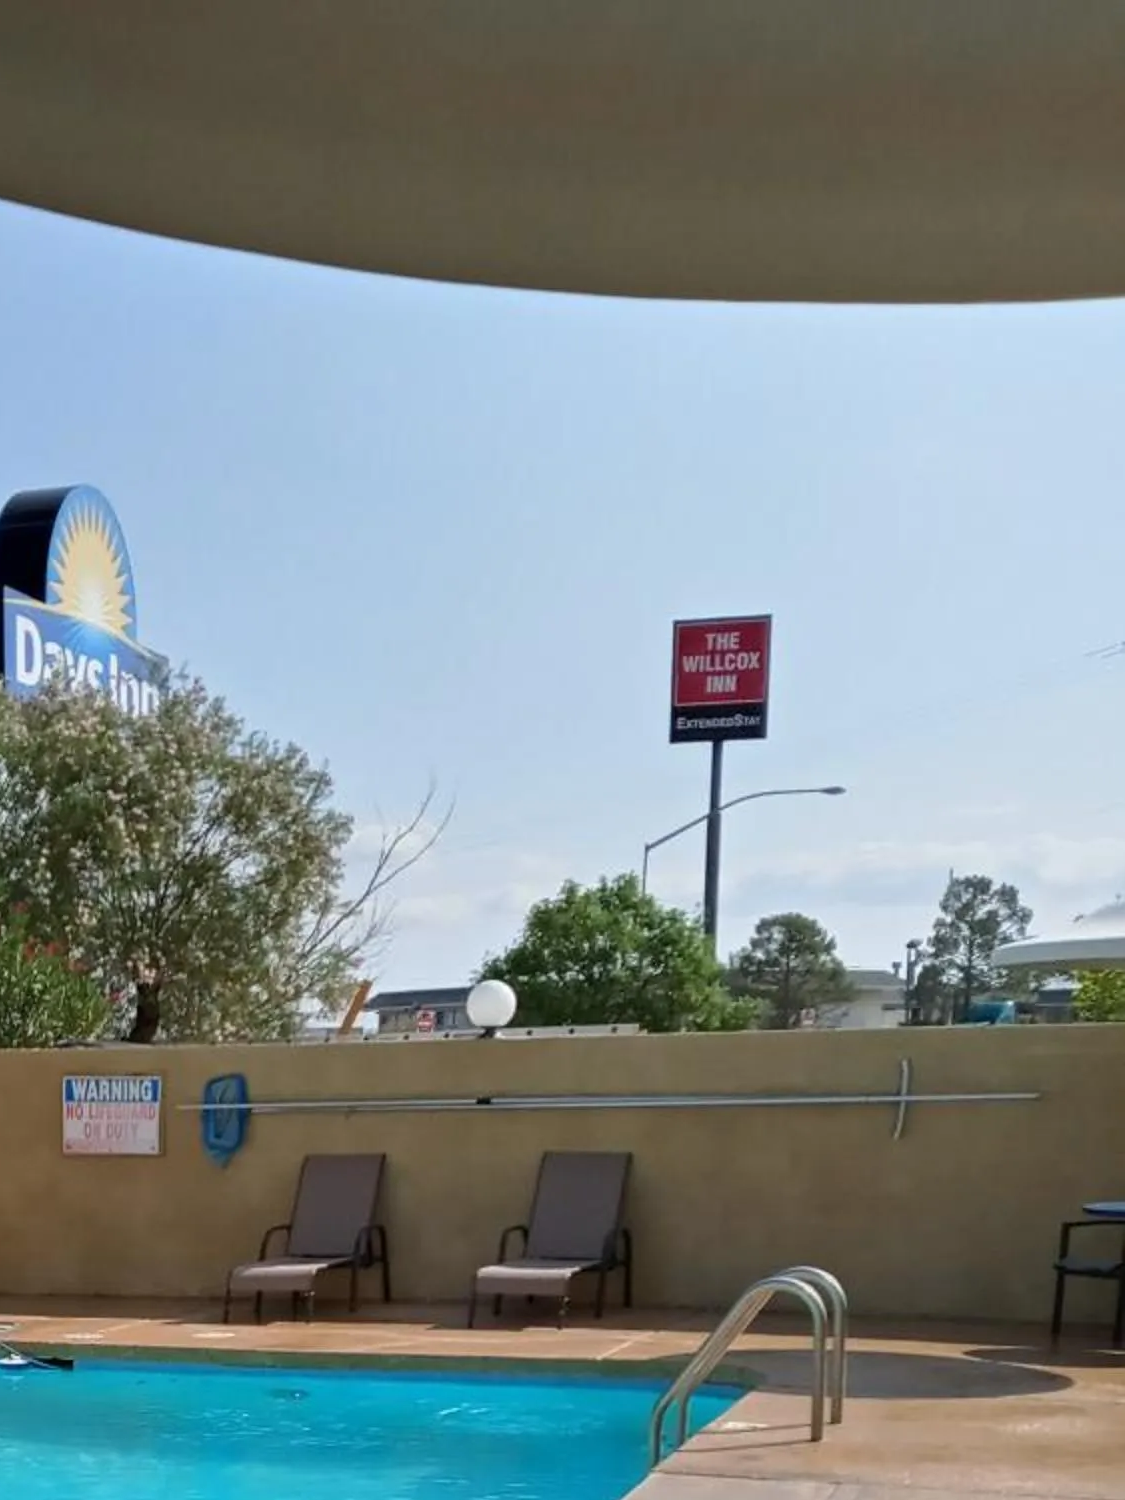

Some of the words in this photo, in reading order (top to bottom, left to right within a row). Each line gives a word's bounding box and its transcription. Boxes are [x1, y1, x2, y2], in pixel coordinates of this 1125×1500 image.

[705, 631, 740, 650] THE
[682, 651, 761, 672] WILLCOX
[706, 674, 739, 693] INN
[71, 1079, 153, 1101] WARNING
[66, 1104, 83, 1120] NO
